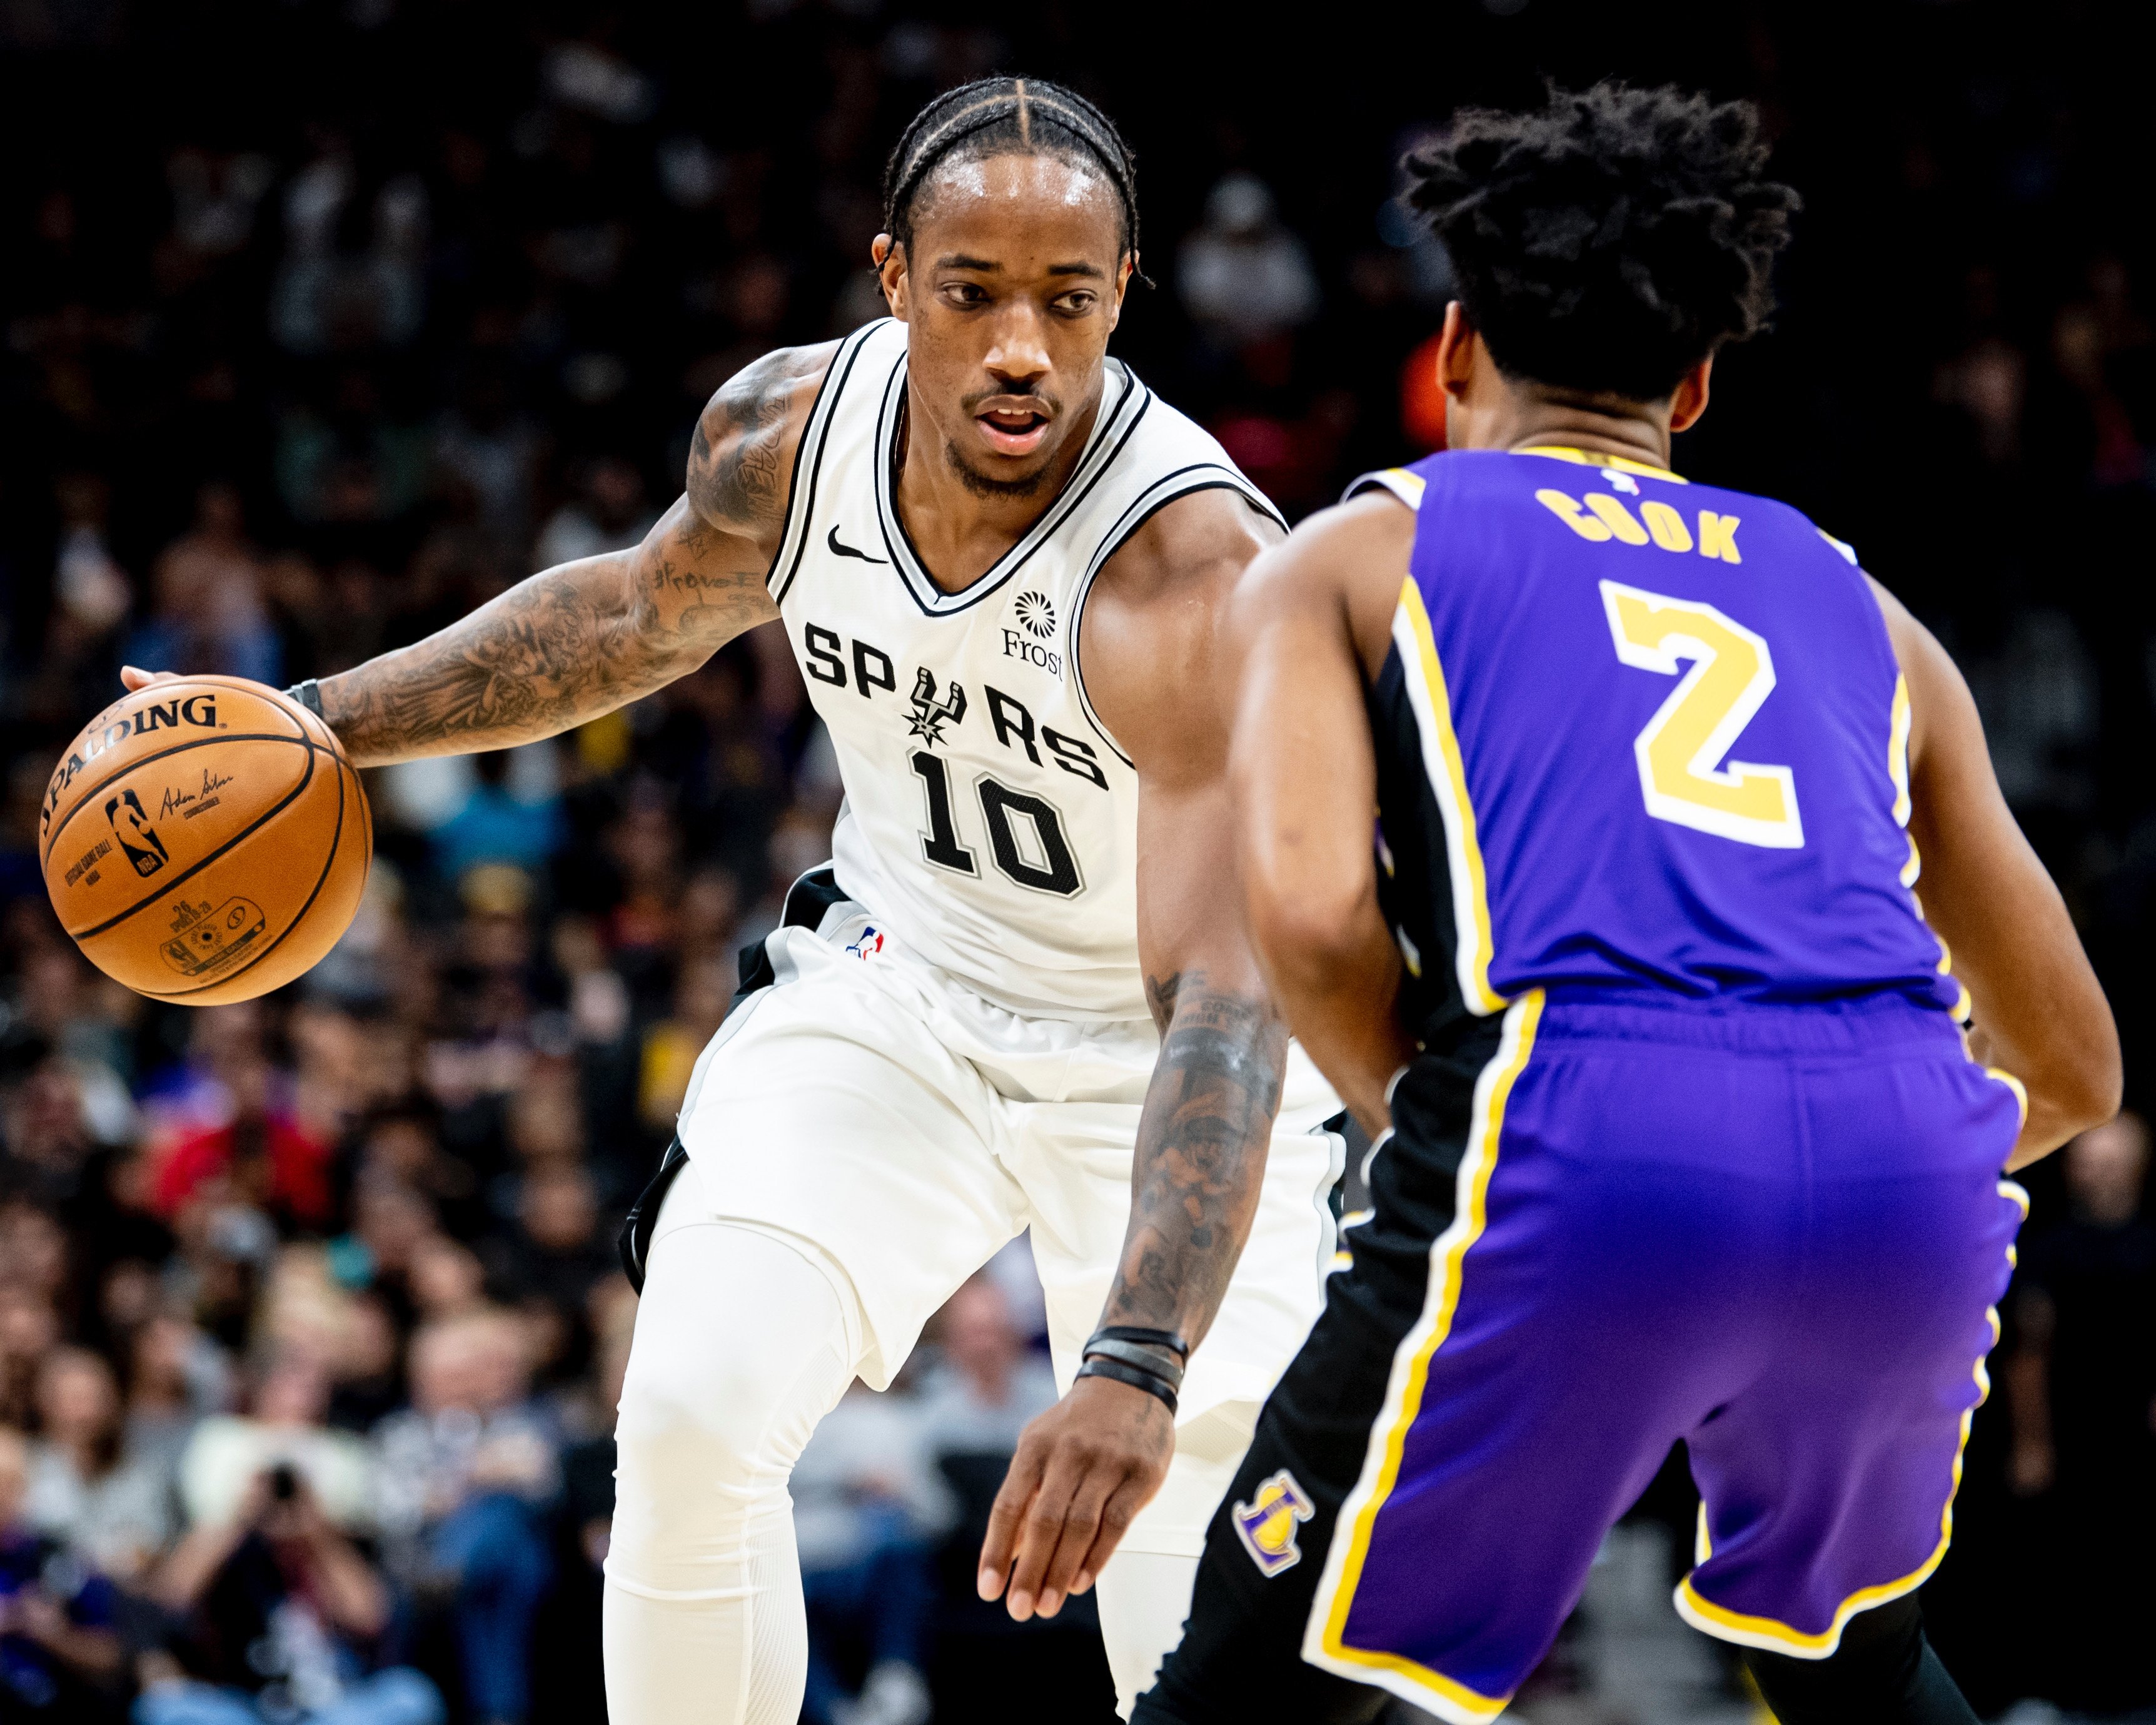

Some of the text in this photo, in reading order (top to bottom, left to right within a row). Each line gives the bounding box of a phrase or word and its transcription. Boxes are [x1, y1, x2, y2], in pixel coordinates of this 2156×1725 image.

[1534, 488, 1742, 565] COOK
[1001, 628, 1063, 682] Frost
[1598, 578, 1805, 849] 2
[159, 787, 195, 821] Adam
[906, 746, 1088, 901] 10
[94, 838, 113, 859] BALL
[136, 854, 157, 875] NBA
